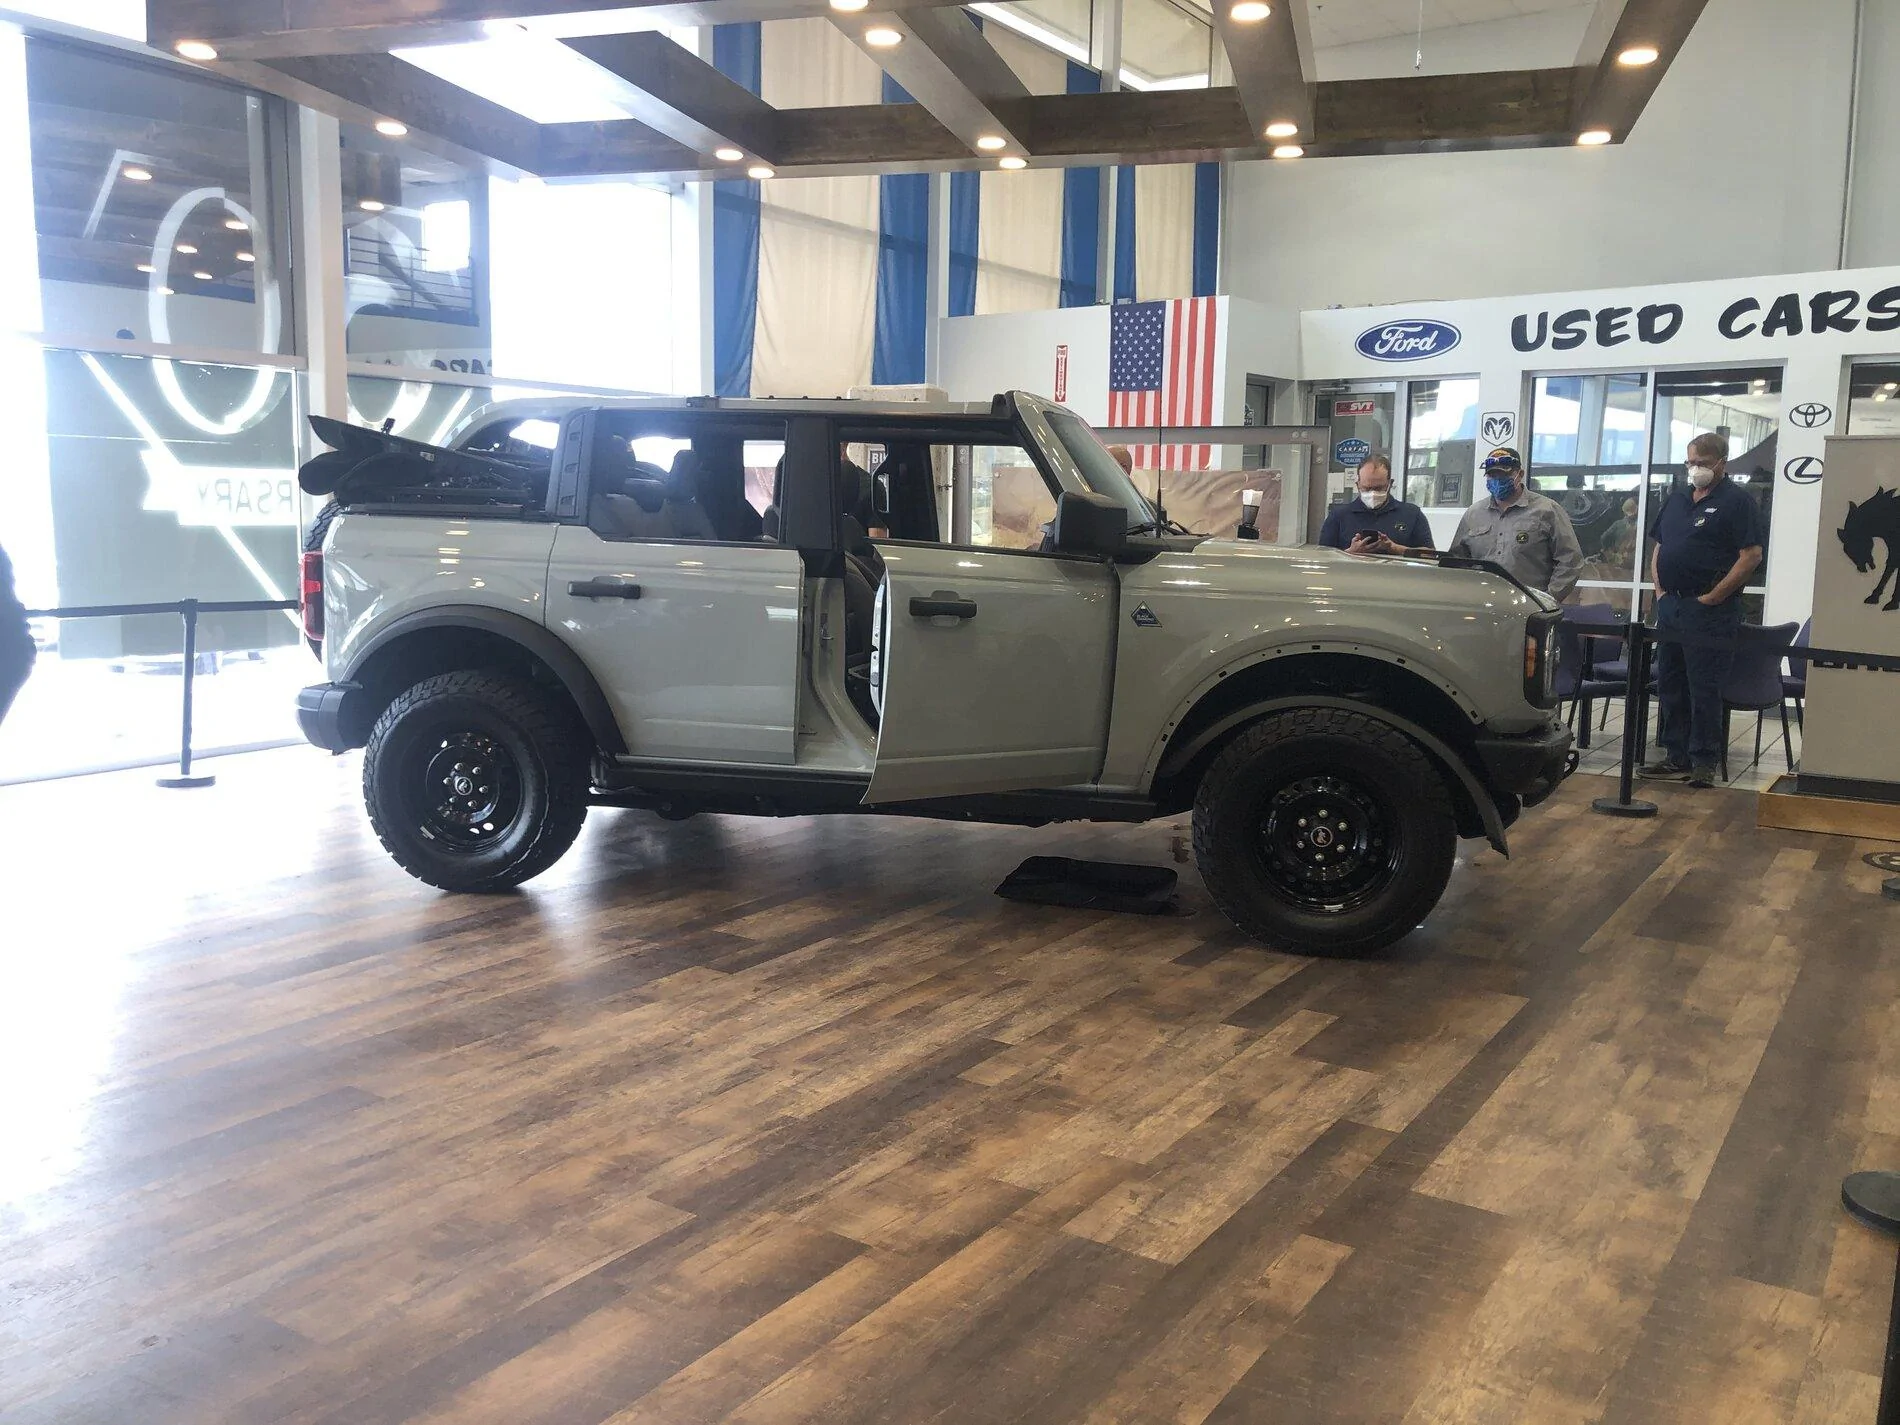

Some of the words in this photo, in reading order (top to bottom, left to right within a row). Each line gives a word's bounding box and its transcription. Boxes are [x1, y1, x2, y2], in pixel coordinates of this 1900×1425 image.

[1511, 303, 1684, 352] USED
[1718, 285, 1900, 340] CARS
[1374, 325, 1439, 354] Ford
[1350, 402, 1373, 411] SVT
